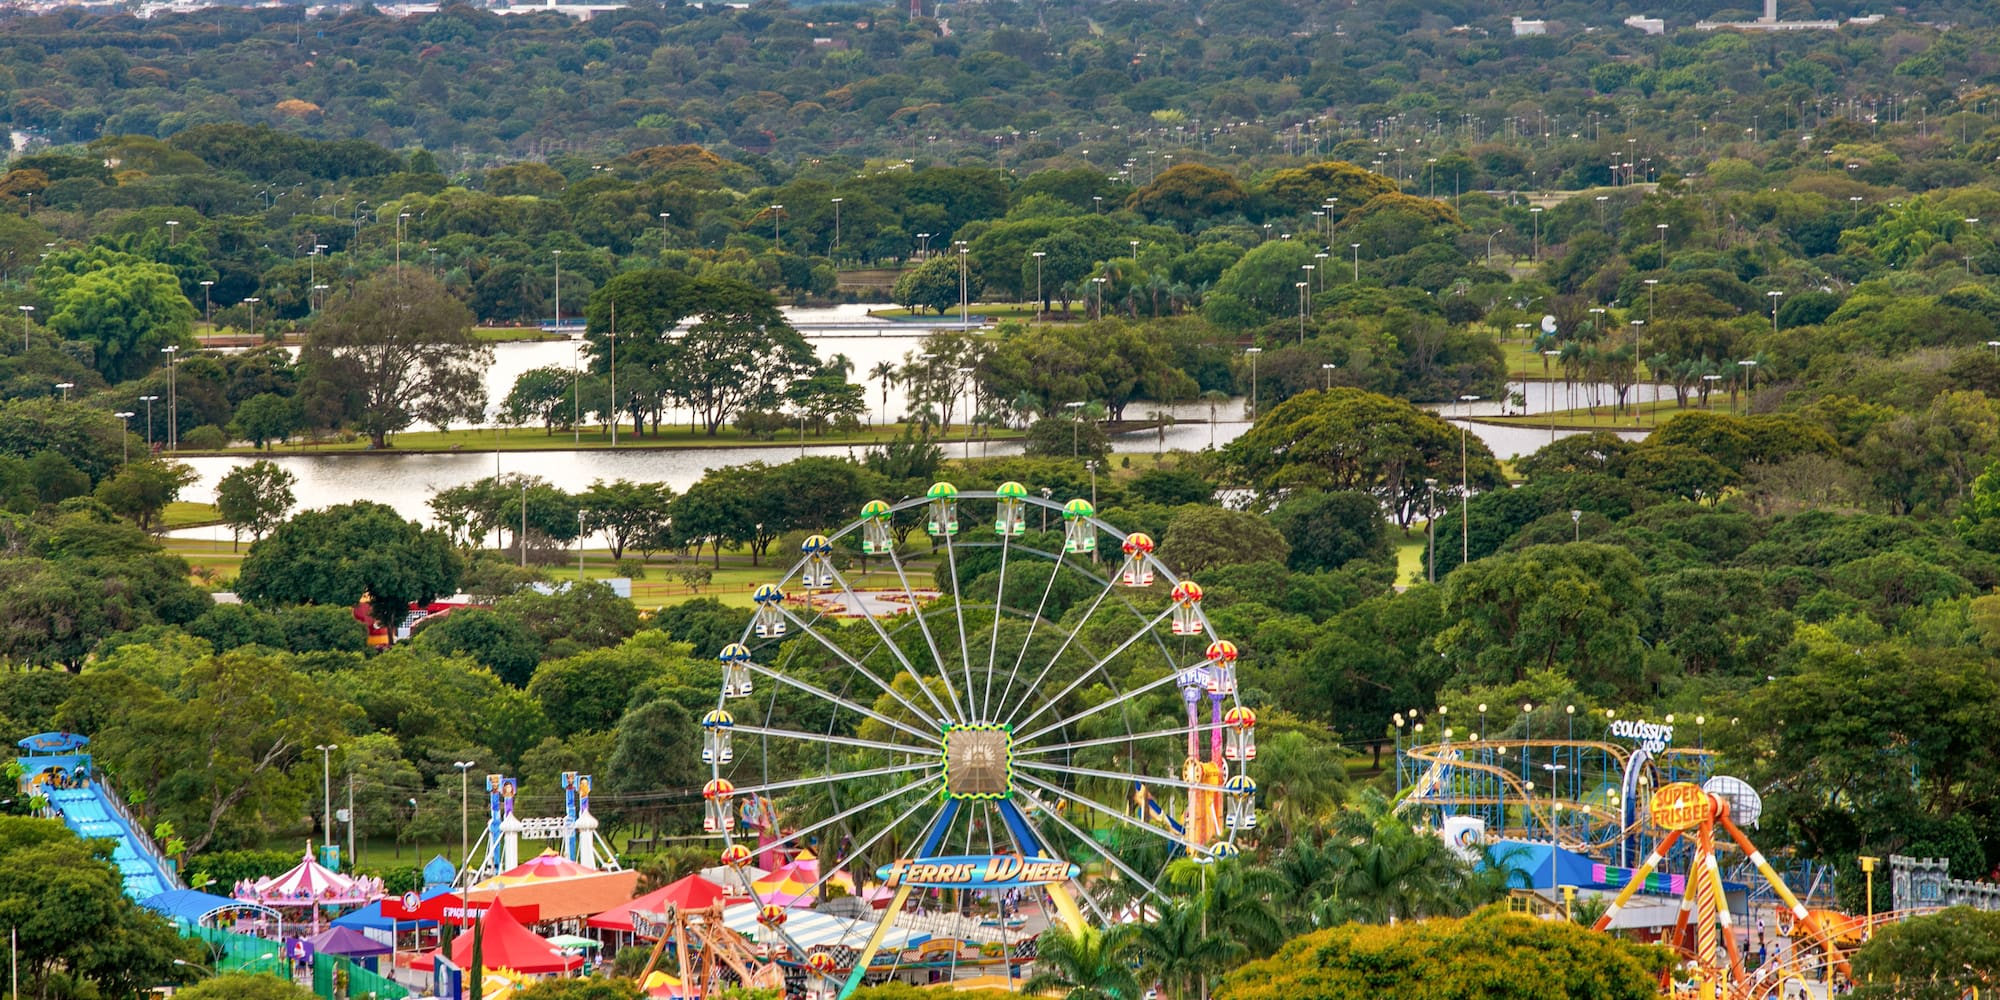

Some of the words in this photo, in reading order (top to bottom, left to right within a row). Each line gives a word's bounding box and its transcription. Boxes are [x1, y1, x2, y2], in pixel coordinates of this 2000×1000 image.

[1611, 720, 1673, 742] COLOSSU'S
[1642, 740, 1665, 753] LOOP
[1657, 785, 1700, 807] SUPER
[1652, 804, 1708, 829] FRISBEE
[886, 859, 978, 887] FERRIS
[983, 854, 1071, 882] WHEEL
